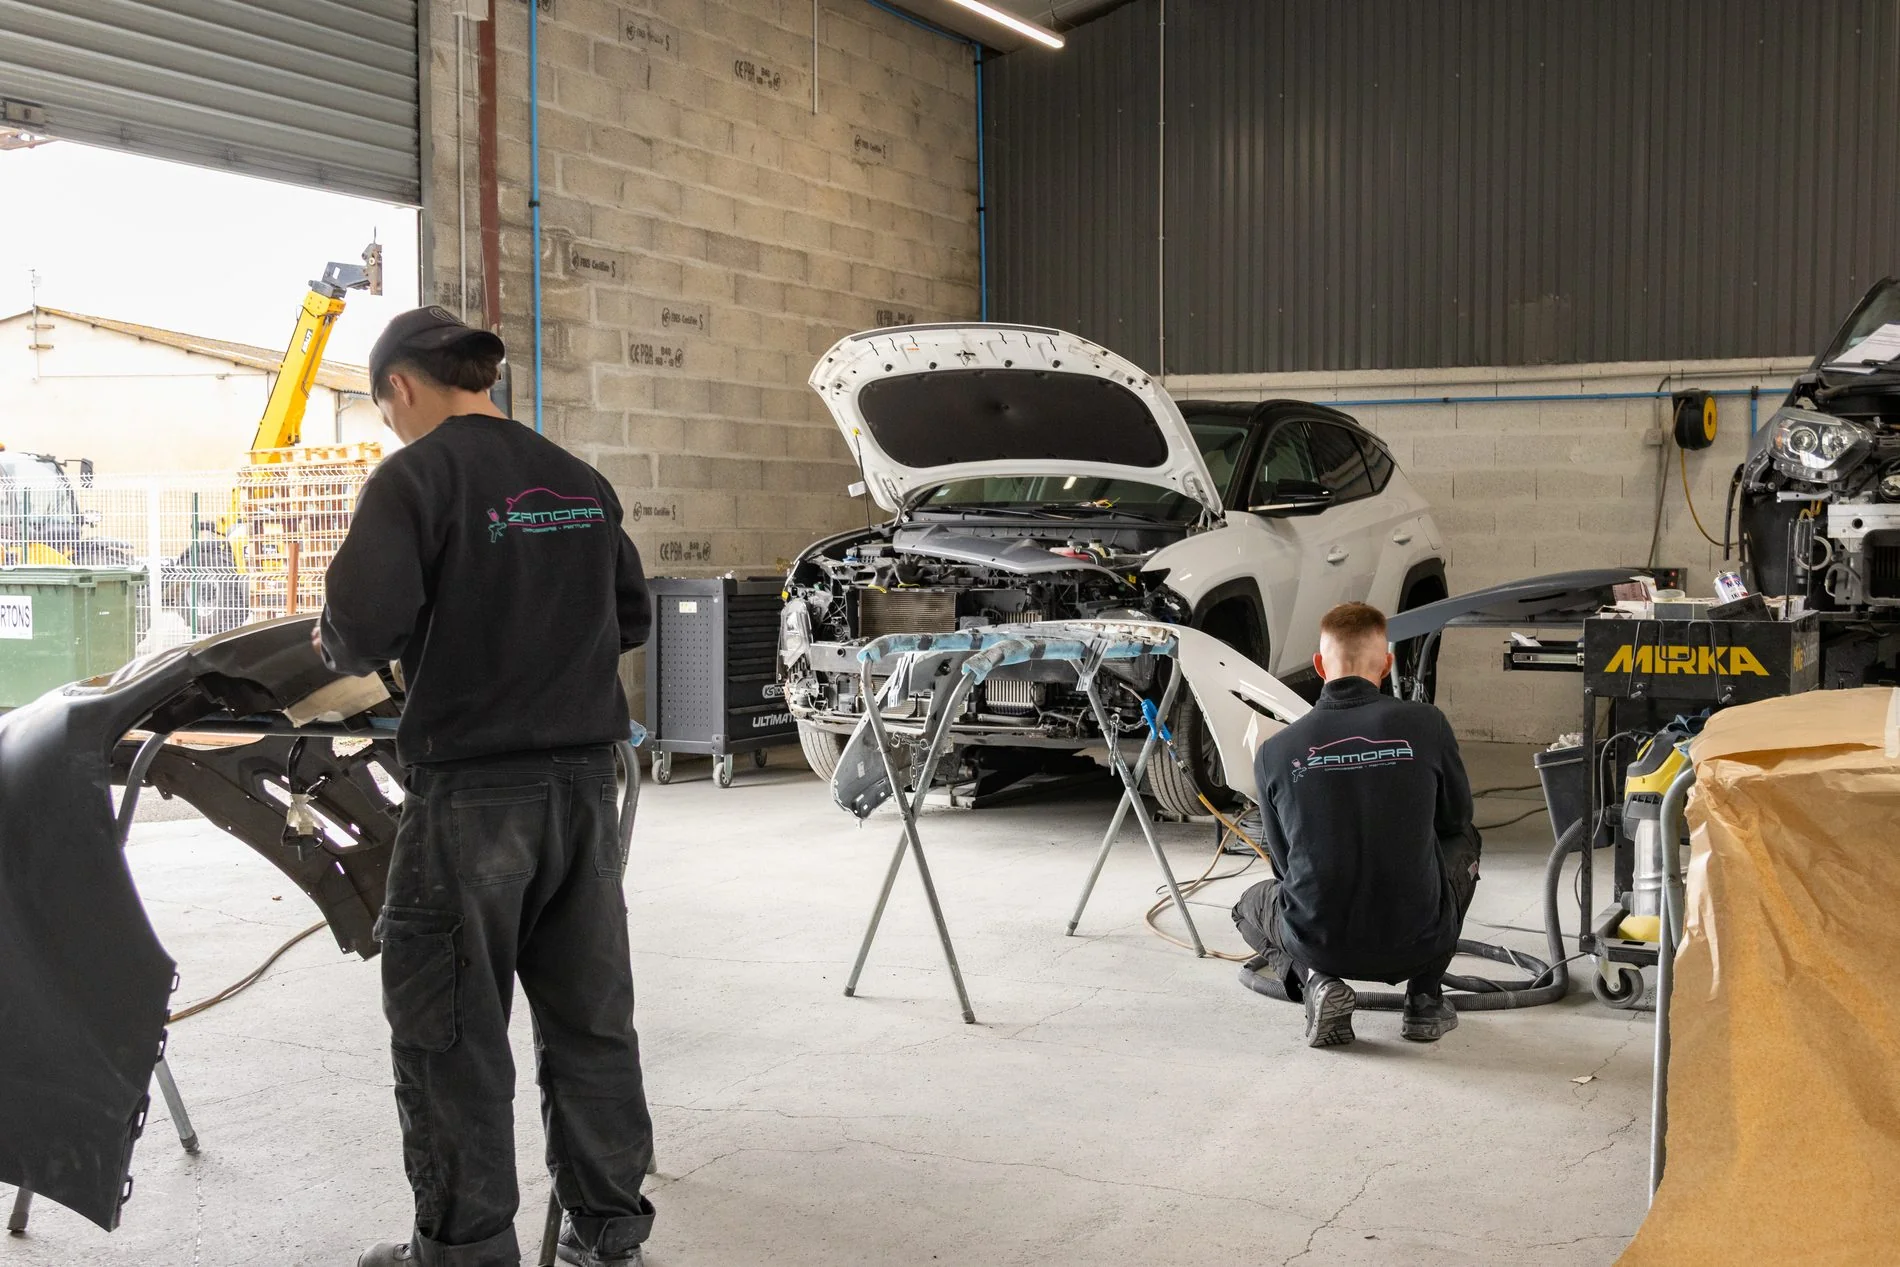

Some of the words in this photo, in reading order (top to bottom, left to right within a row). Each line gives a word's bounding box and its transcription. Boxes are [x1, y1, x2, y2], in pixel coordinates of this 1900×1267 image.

[507, 508, 605, 524] ZAMORA
[1, 605, 30, 628] RTONS
[1604, 645, 1770, 676] MIRKA
[1307, 748, 1413, 766] ZAMORA
